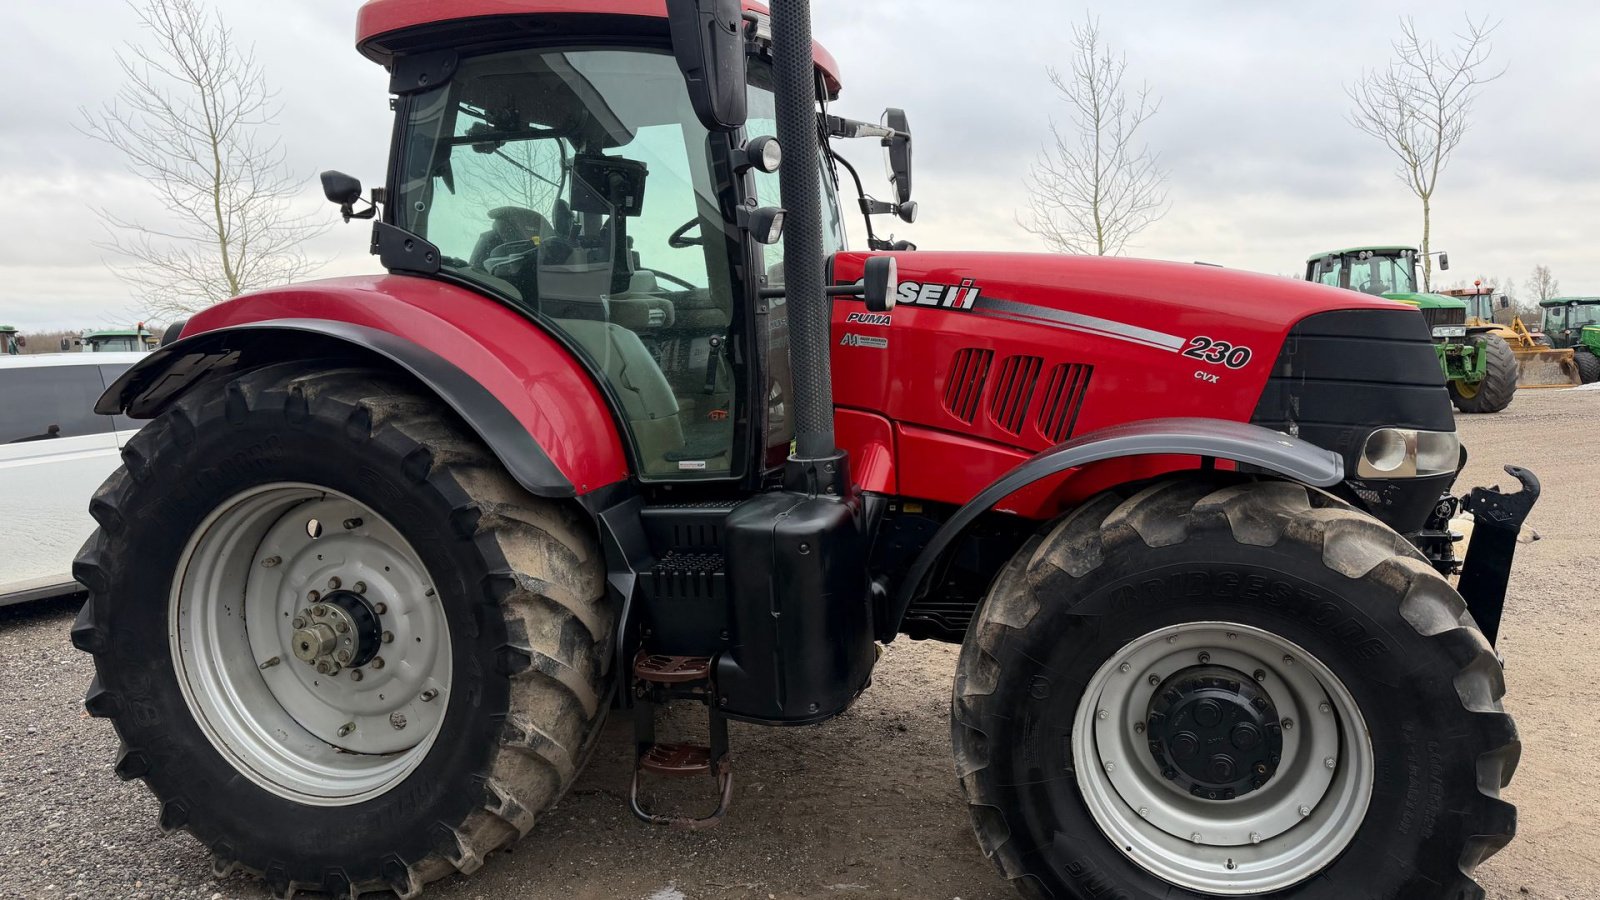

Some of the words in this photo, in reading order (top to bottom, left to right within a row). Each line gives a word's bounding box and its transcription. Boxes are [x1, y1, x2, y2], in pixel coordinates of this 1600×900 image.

[846, 312, 891, 326] PUMA
[1182, 335, 1252, 370] 230
[1108, 570, 1390, 658] BRIDGESTONE
